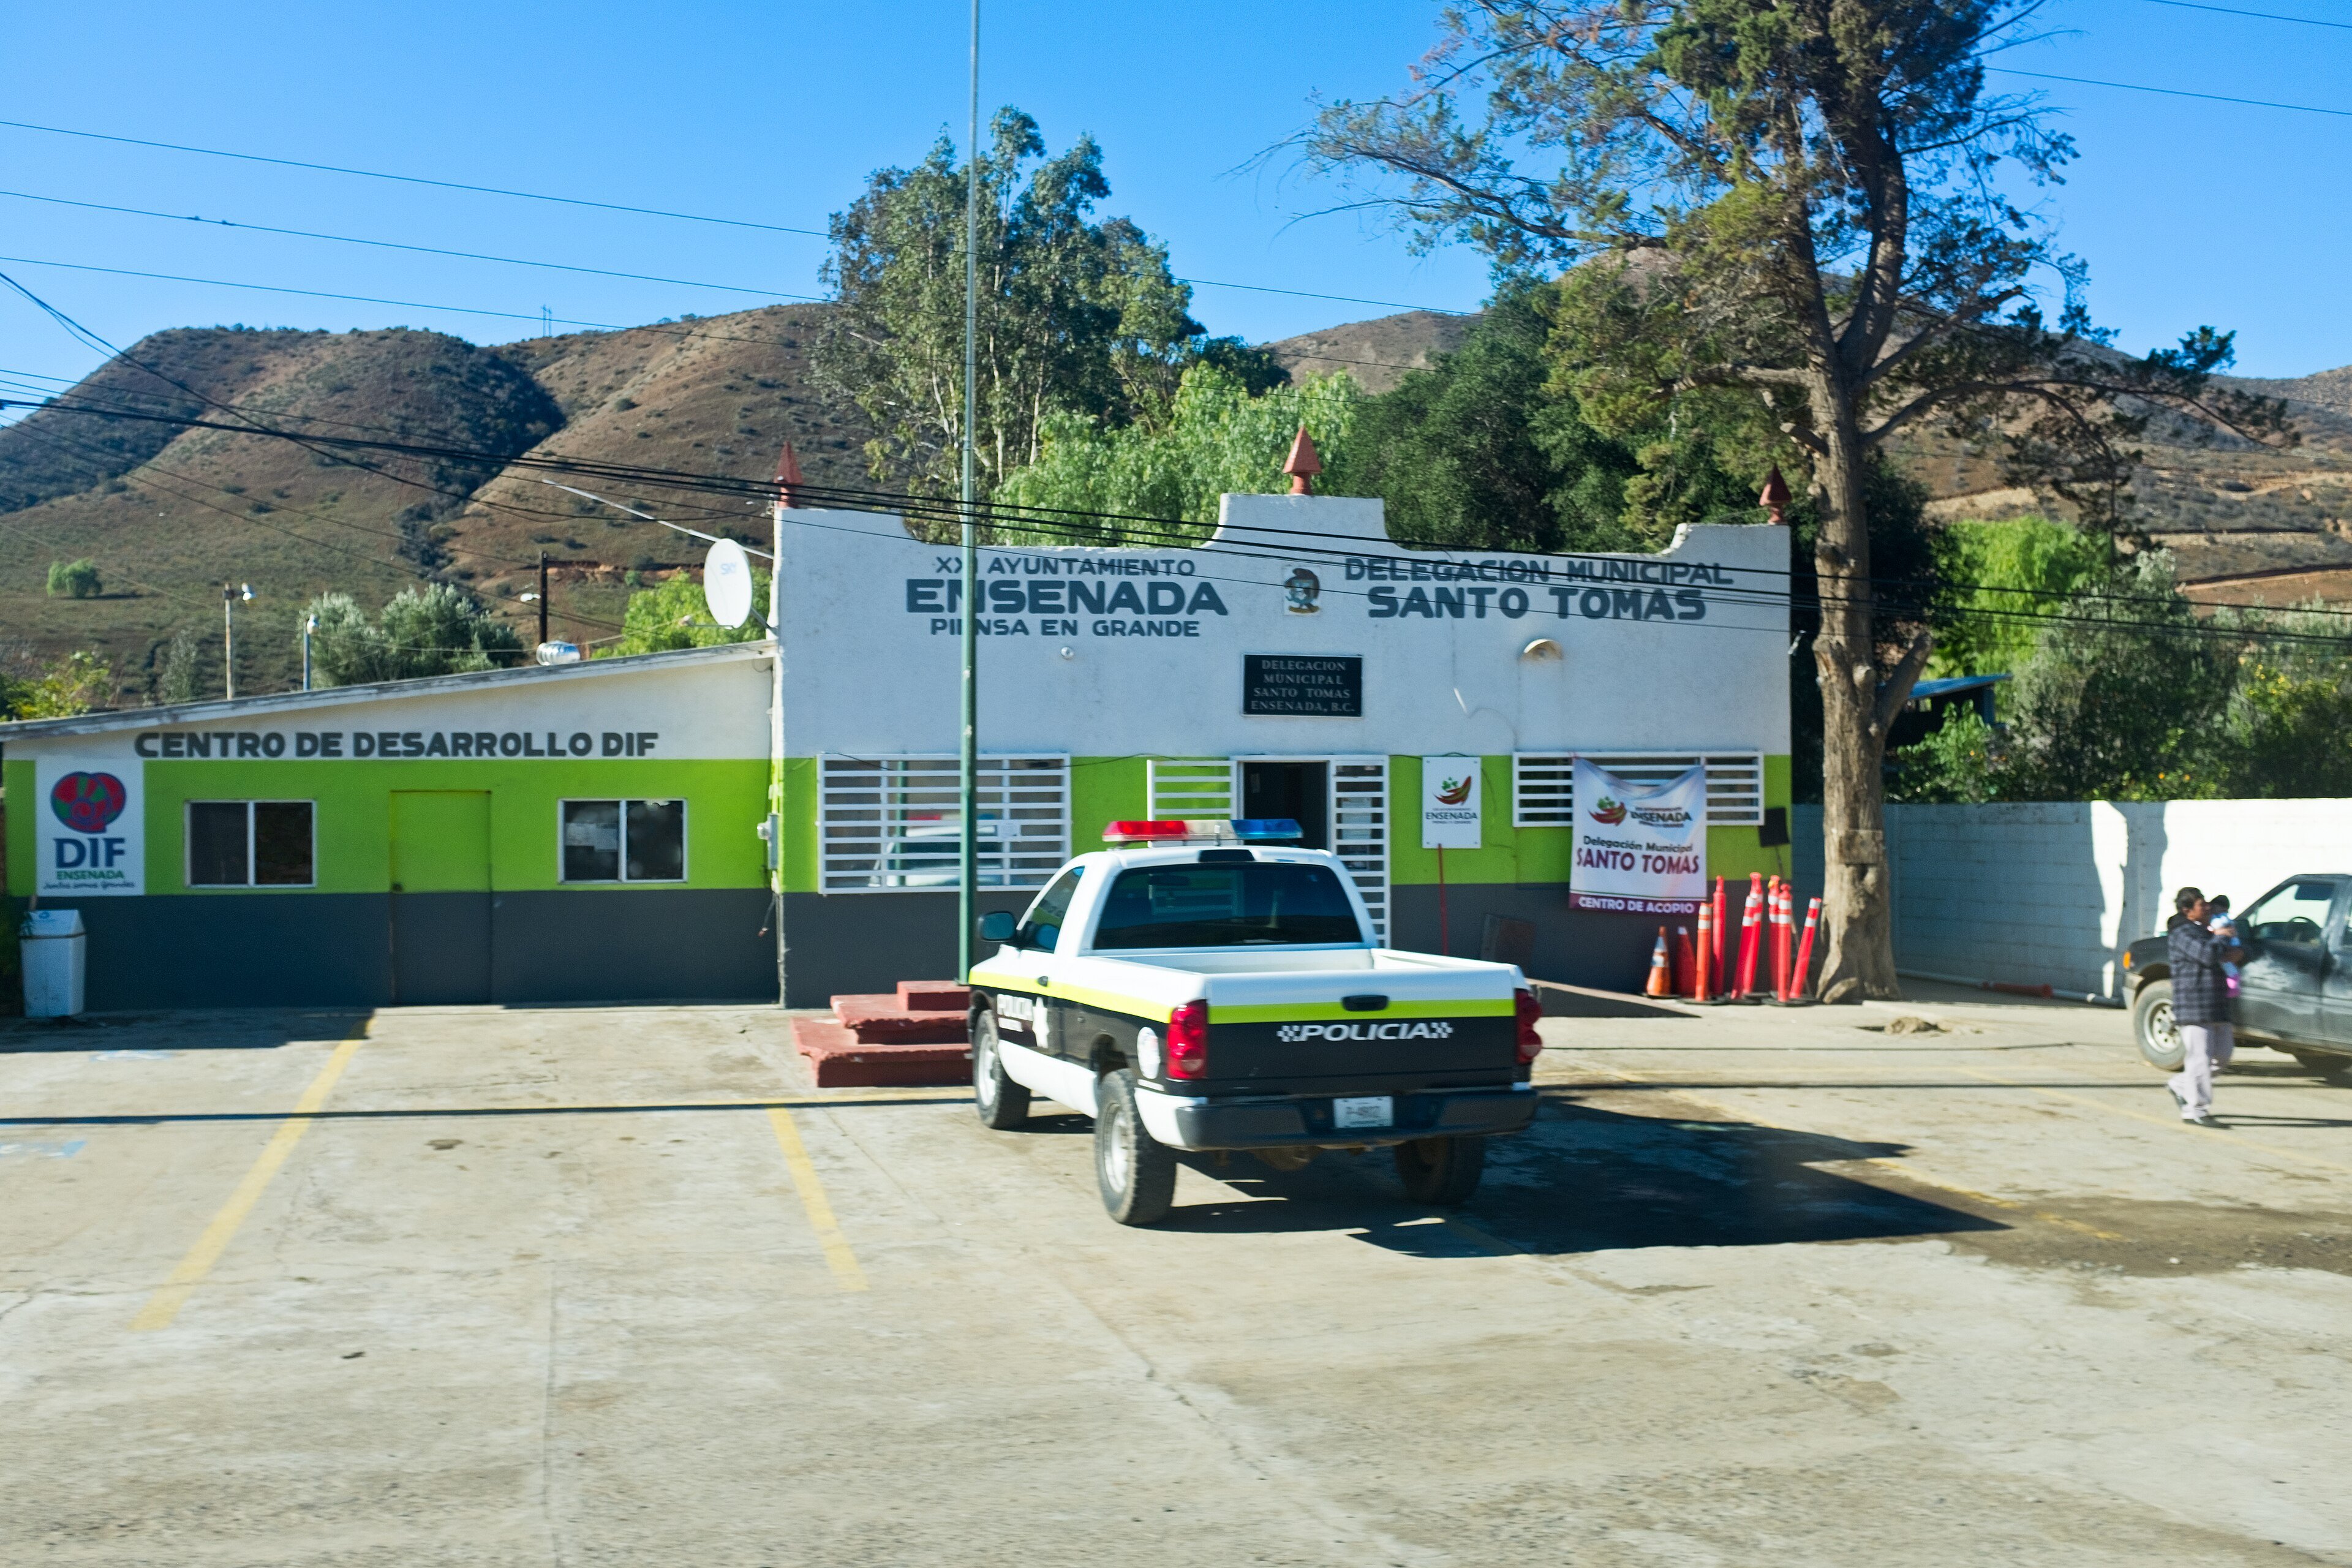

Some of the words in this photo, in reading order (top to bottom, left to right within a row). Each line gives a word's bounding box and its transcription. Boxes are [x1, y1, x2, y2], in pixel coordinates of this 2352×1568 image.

[987, 557, 1196, 576] AYUNTAMIENTO
[1345, 557, 1550, 583] DELEGACION
[1567, 560, 1735, 585] MUNICIPAL
[906, 578, 1229, 616] ENSENADA
[1368, 586, 1530, 619] SANTO
[1549, 586, 1708, 621] TOMAS
[930, 618, 1030, 636] PINSA
[1042, 619, 1078, 636] EN
[1093, 619, 1200, 638] GRANDE
[1261, 660, 1346, 671] DELEGACION
[1263, 673, 1344, 685] MUNICIPAL
[1254, 687, 1298, 698] SANTO
[1306, 688, 1351, 699] TOMAS
[1251, 700, 1328, 712] ENSENADA,
[134, 731, 286, 758] CENTRO
[295, 732, 343, 758] DE
[352, 731, 594, 758] DESARROLLO
[601, 732, 660, 757] DIF
[1630, 811, 1693, 823] ENSENADA
[53, 837, 126, 869] DIF
[1577, 847, 1635, 871] SANTO
[56, 870, 124, 880] ENSENADA
[1578, 896, 1625, 910] CENTRO
[1627, 900, 1644, 912] DE
[1646, 902, 1695, 913] ACOPIO
[1293, 1022, 1433, 1042] POLICIA
